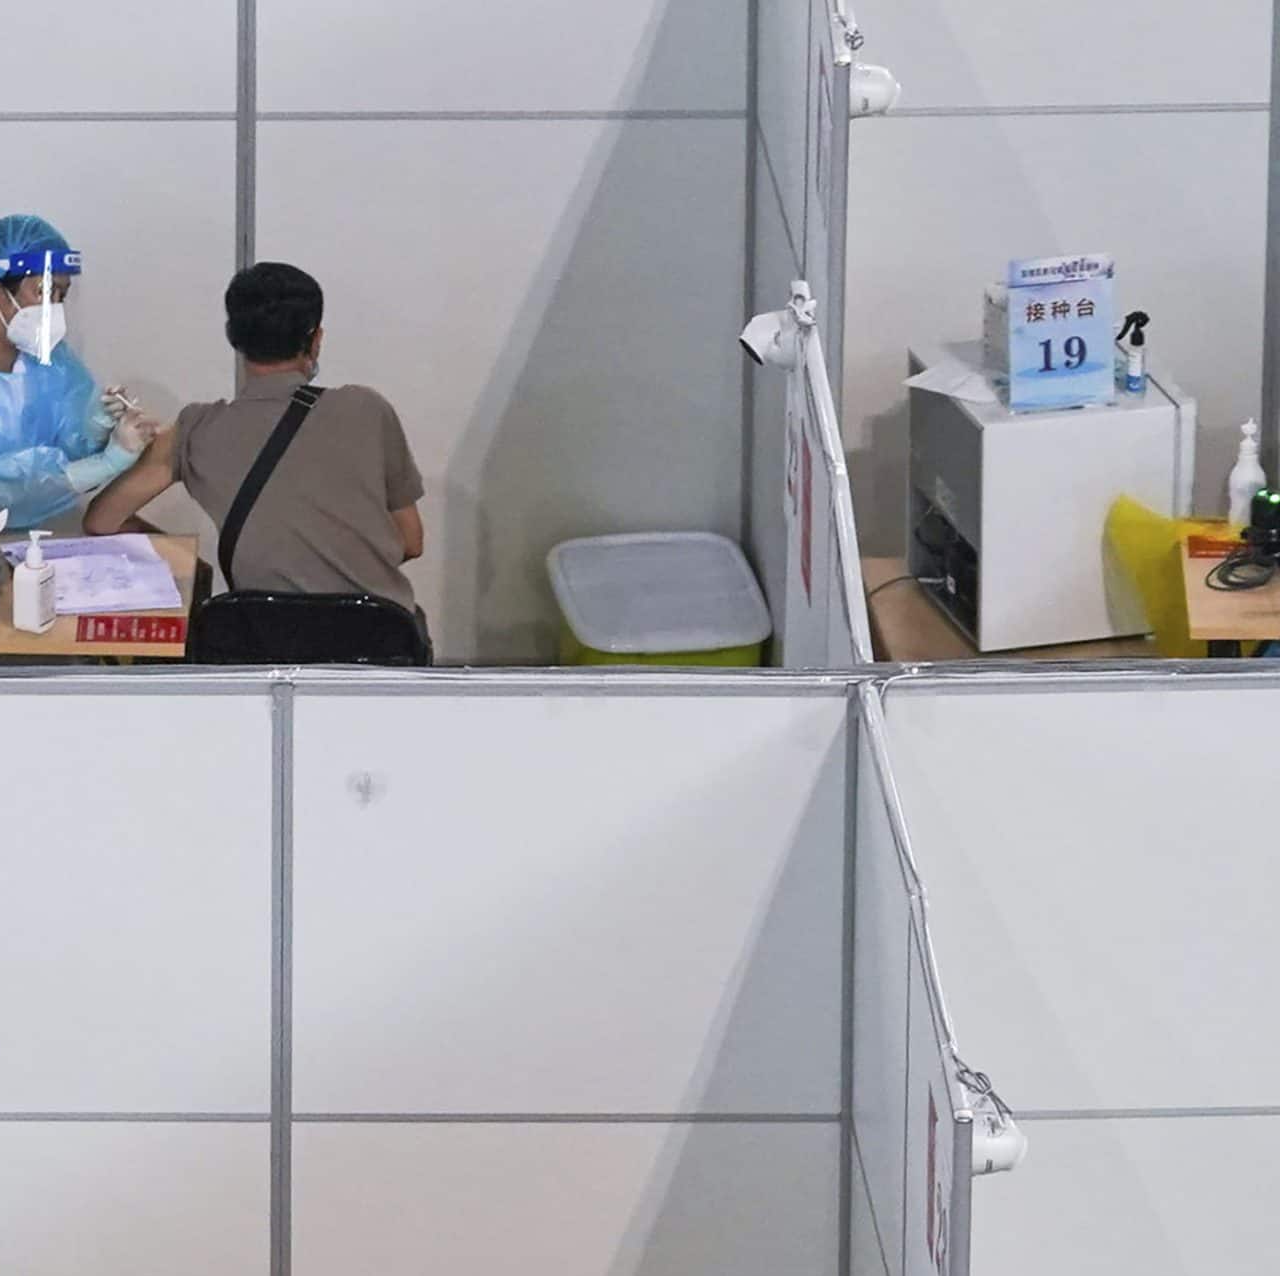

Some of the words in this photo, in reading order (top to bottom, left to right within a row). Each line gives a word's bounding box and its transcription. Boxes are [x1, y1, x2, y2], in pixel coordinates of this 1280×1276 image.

[1025, 298, 1096, 323] 接种台
[1038, 335, 1087, 373] 19
